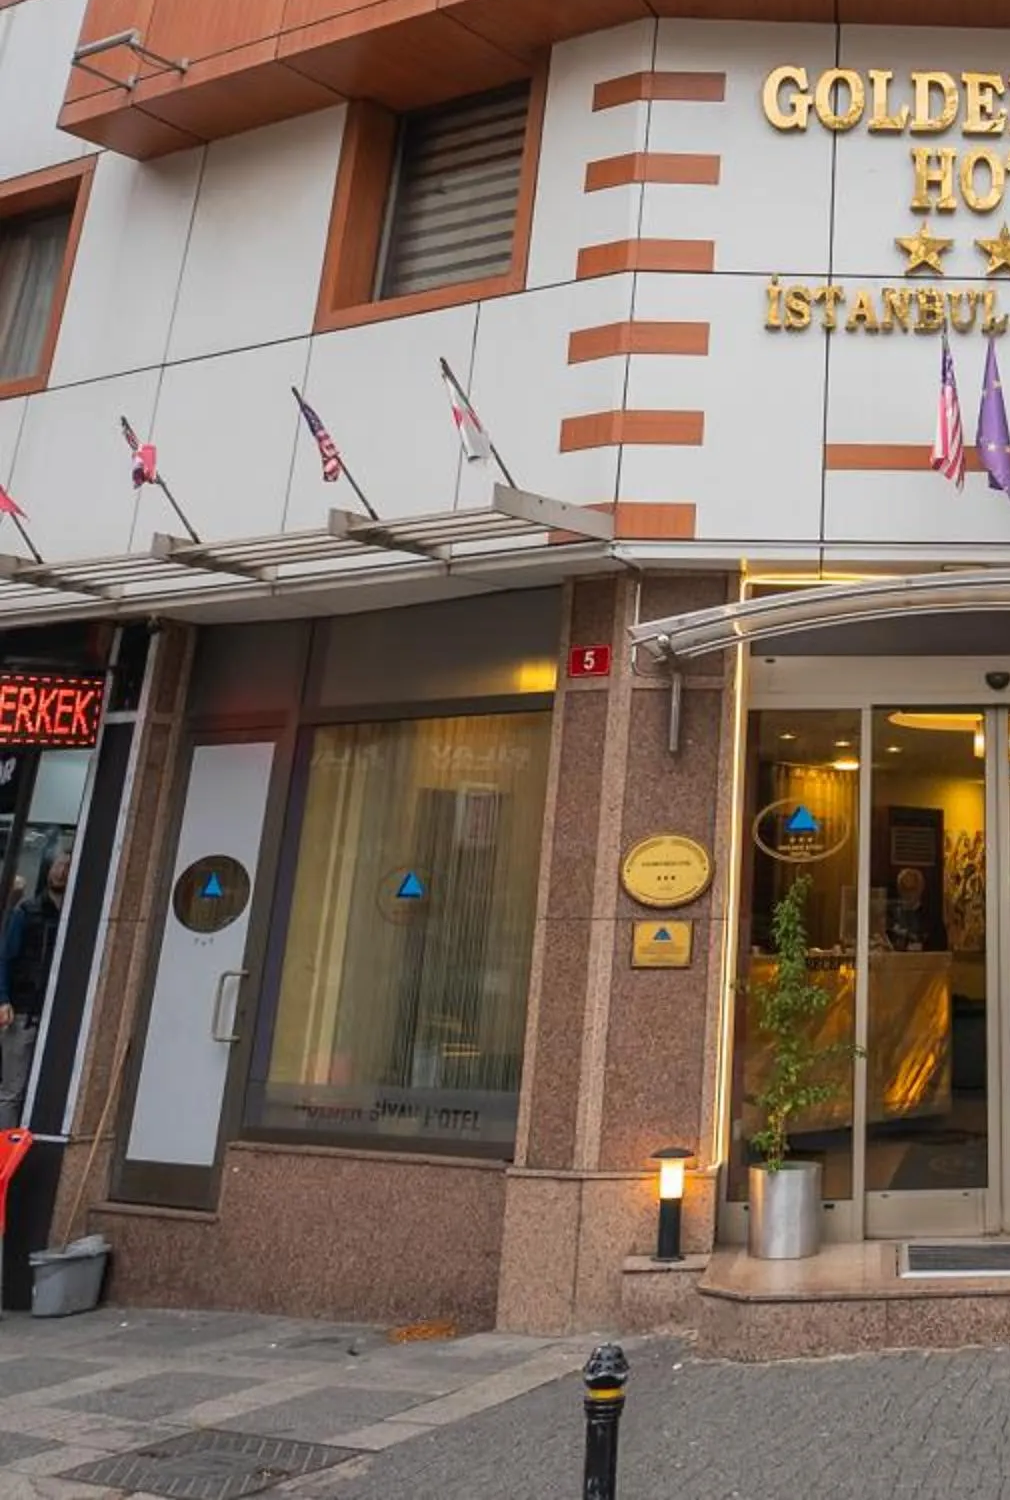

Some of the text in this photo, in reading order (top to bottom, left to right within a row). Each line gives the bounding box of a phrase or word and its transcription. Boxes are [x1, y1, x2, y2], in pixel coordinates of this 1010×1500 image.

[764, 272, 1009, 334] İSTANBUL
[583, 650, 596, 671] 5
[0, 685, 95, 736] ERKEK
